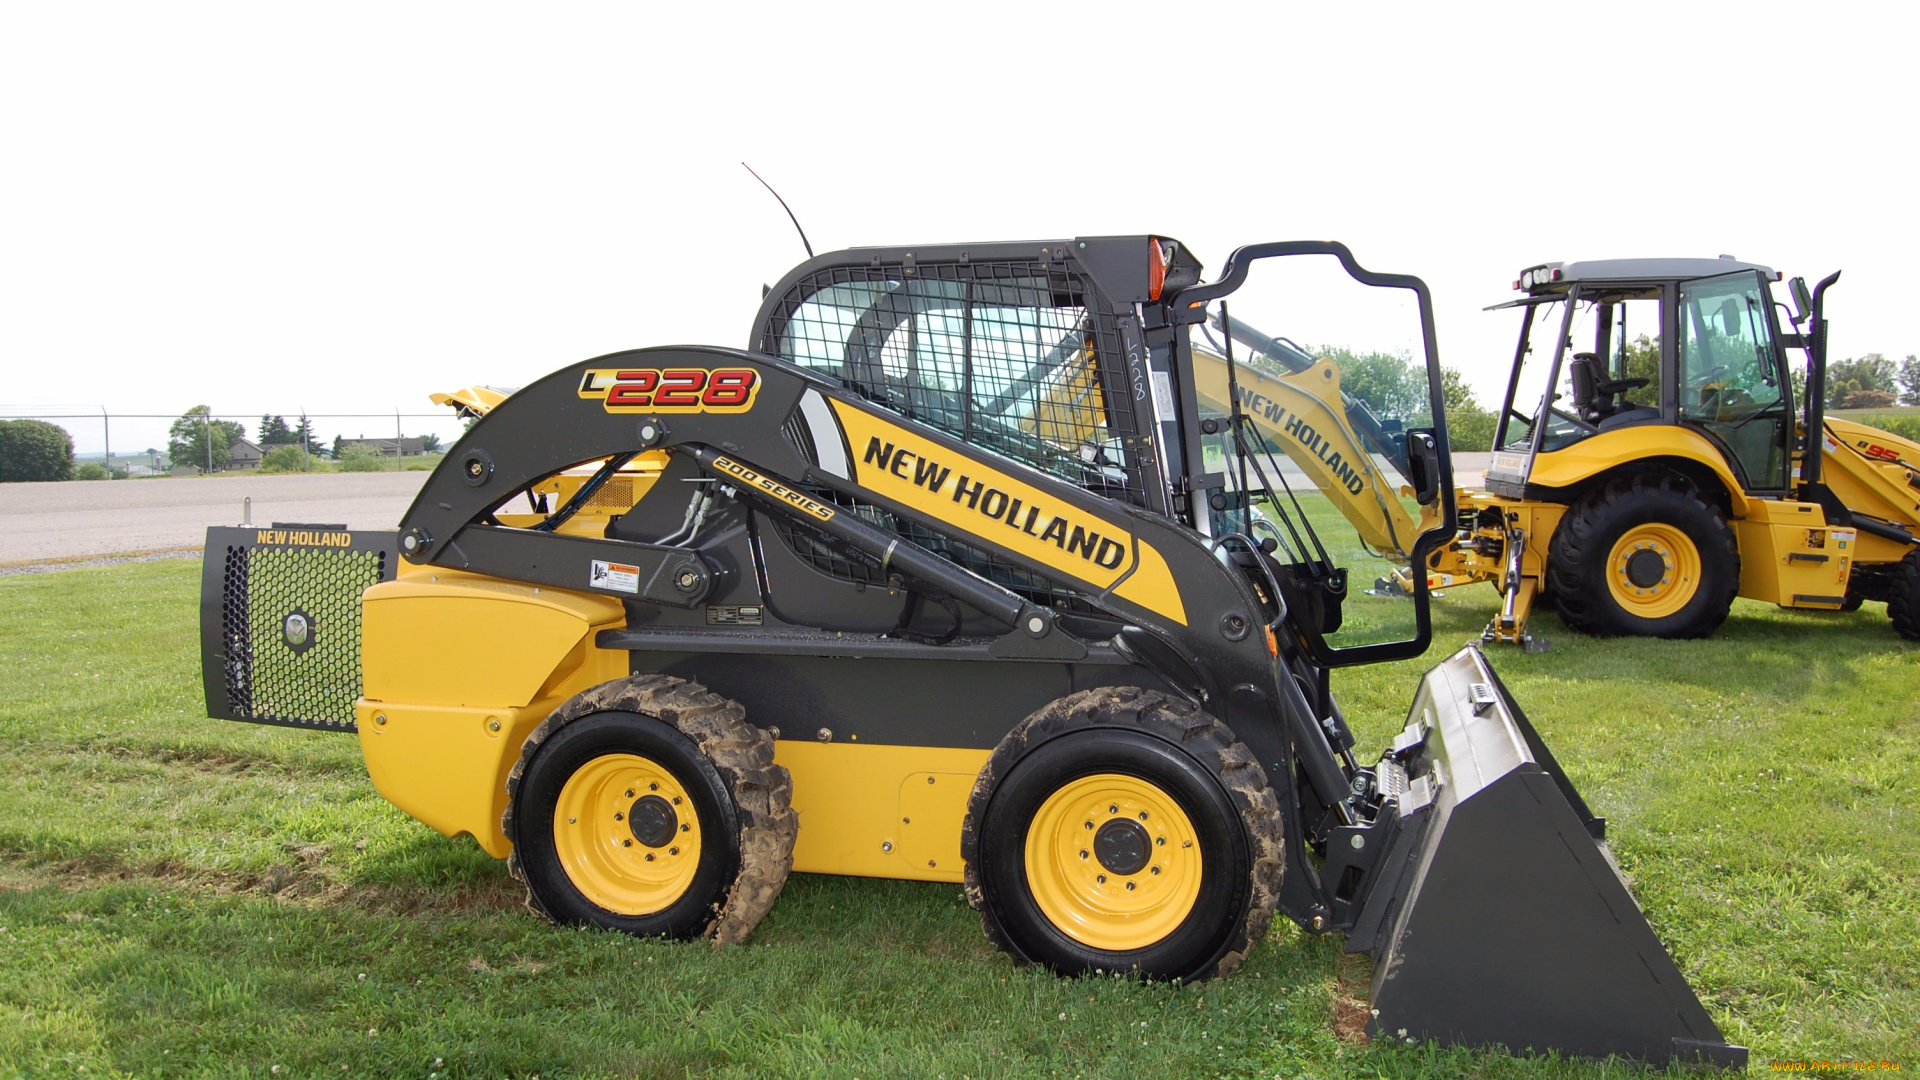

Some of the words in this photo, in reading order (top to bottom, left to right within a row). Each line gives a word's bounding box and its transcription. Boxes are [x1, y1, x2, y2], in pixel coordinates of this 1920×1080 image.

[1127, 337, 1146, 401] L228
[1237, 385, 1286, 425] NEW
[1284, 413, 1364, 496] HOLLAND
[714, 458, 759, 482] 200
[759, 479, 833, 518] SERIES
[863, 435, 951, 494] NEW
[951, 474, 1126, 571] HOLLAND
[257, 530, 287, 545] NEW
[288, 531, 351, 547] HOLLAND
